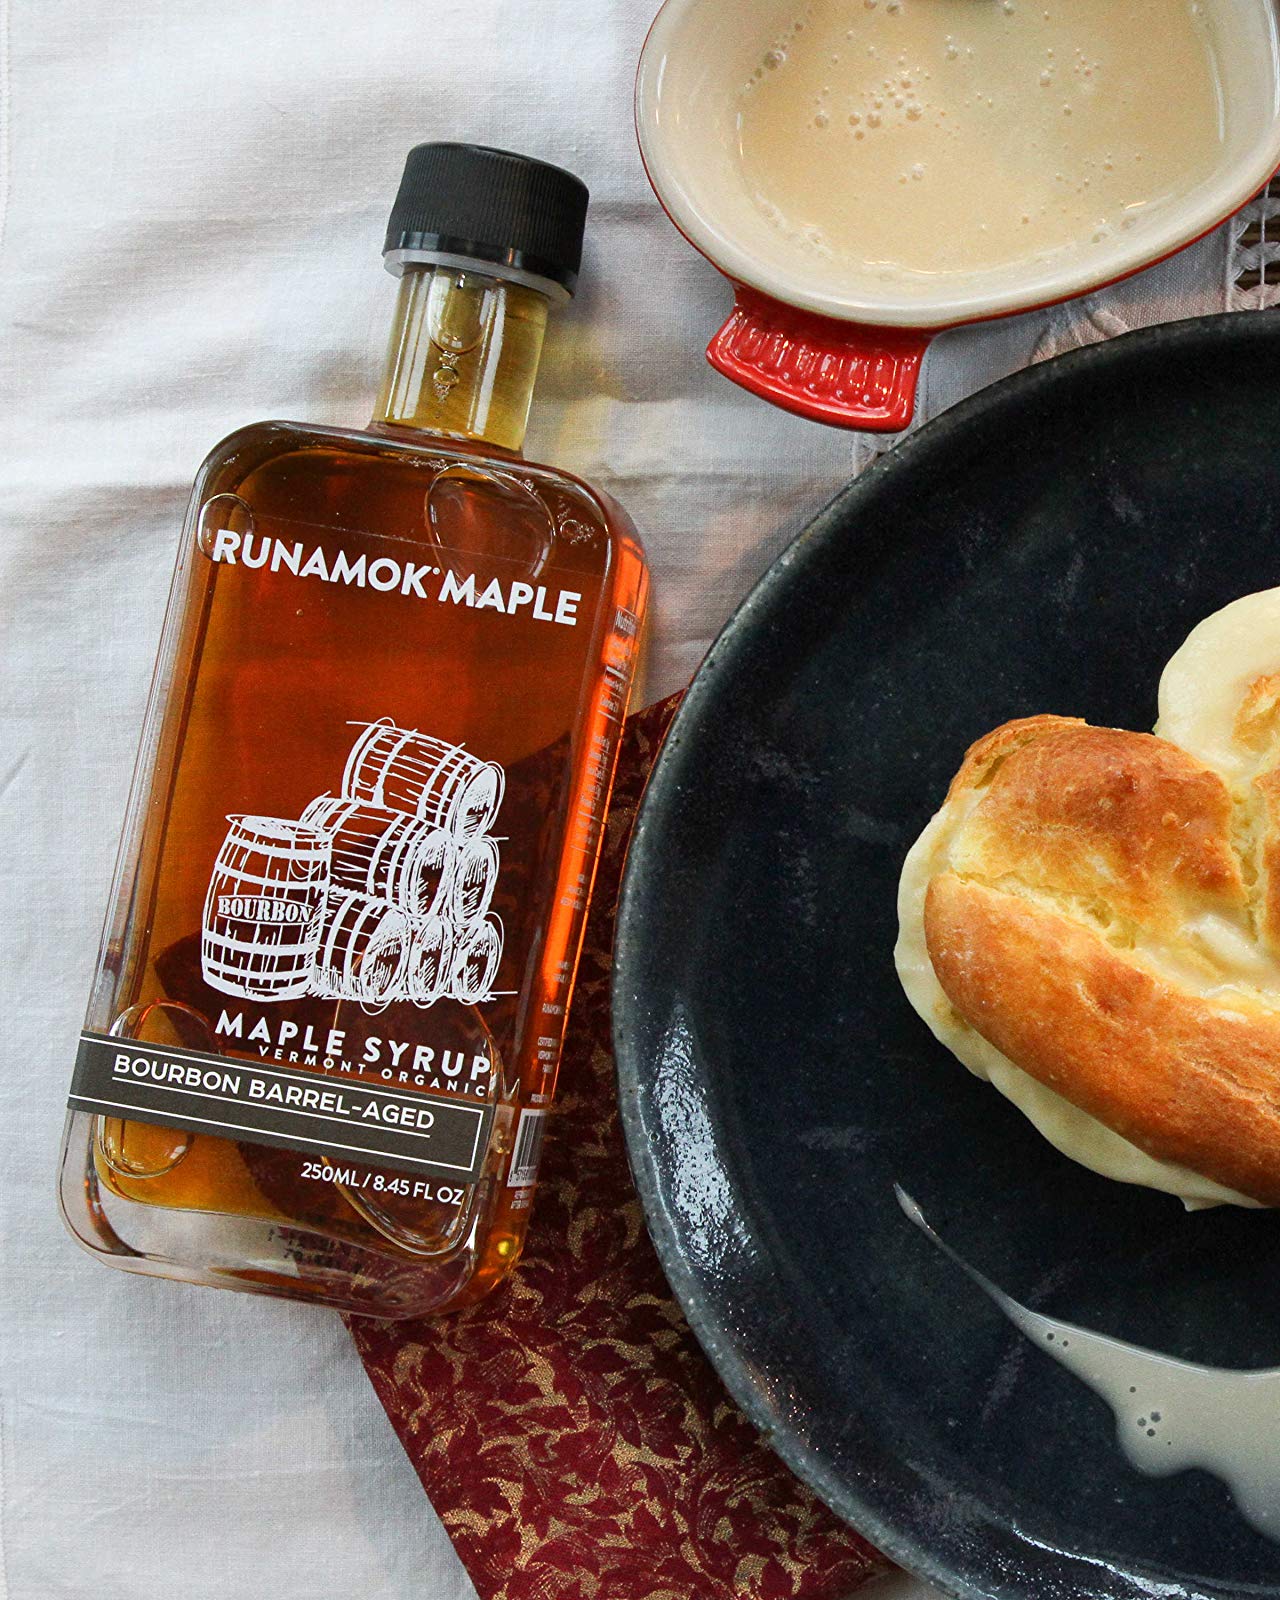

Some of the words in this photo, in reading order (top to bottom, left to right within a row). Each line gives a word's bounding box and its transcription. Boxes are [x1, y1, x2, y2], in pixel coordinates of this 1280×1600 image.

[212, 529, 434, 599] RUNAMOK
[437, 569, 582, 626] MAPLE
[217, 897, 312, 923] BOURBON
[215, 1009, 346, 1056] MAPLE
[362, 1036, 491, 1081] SYRUP
[258, 1045, 366, 1075] VERMONT
[381, 1068, 486, 1097] ORGANIC
[113, 1054, 241, 1094] BOURBON
[248, 1079, 435, 1130] BARREL-AGED
[300, 1162, 360, 1187] 250ML
[372, 1175, 410, 1196] 8.45
[412, 1181, 433, 1200] FL
[436, 1186, 465, 1206] OZ
